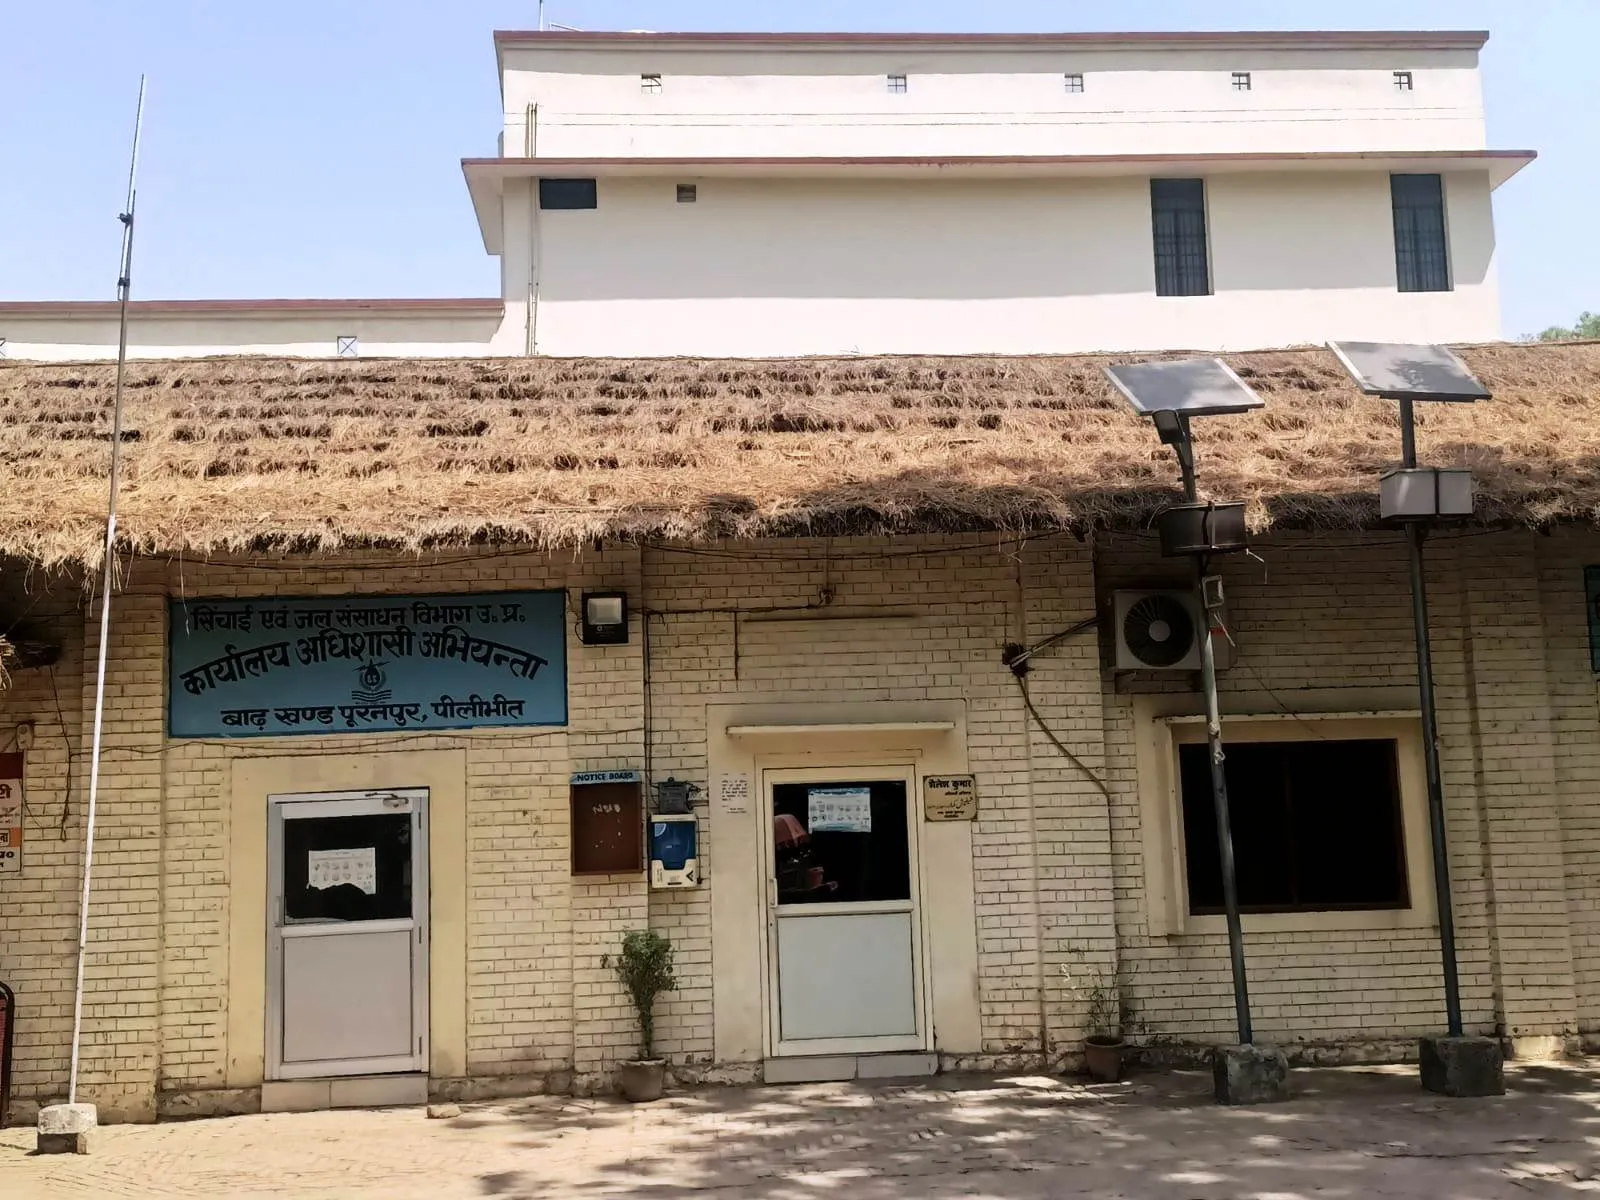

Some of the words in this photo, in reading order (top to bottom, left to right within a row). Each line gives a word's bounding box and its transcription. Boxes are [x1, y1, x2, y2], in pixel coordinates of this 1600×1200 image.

[191, 605, 253, 632] सिंचाई
[258, 606, 290, 629] एवं
[293, 609, 333, 629] जल
[335, 604, 406, 629] संसाधन
[411, 601, 473, 626] विभाग
[179, 641, 290, 695] कार्यालय
[295, 625, 416, 666] अधिशासी
[418, 625, 548, 680] अभियन्ता
[221, 708, 269, 731] बाढ़
[274, 706, 335, 726] खण्ड
[431, 693, 525, 719] पीलीभीत
[576, 773, 605, 782] NOTICE
[608, 772, 634, 780] BOARD
